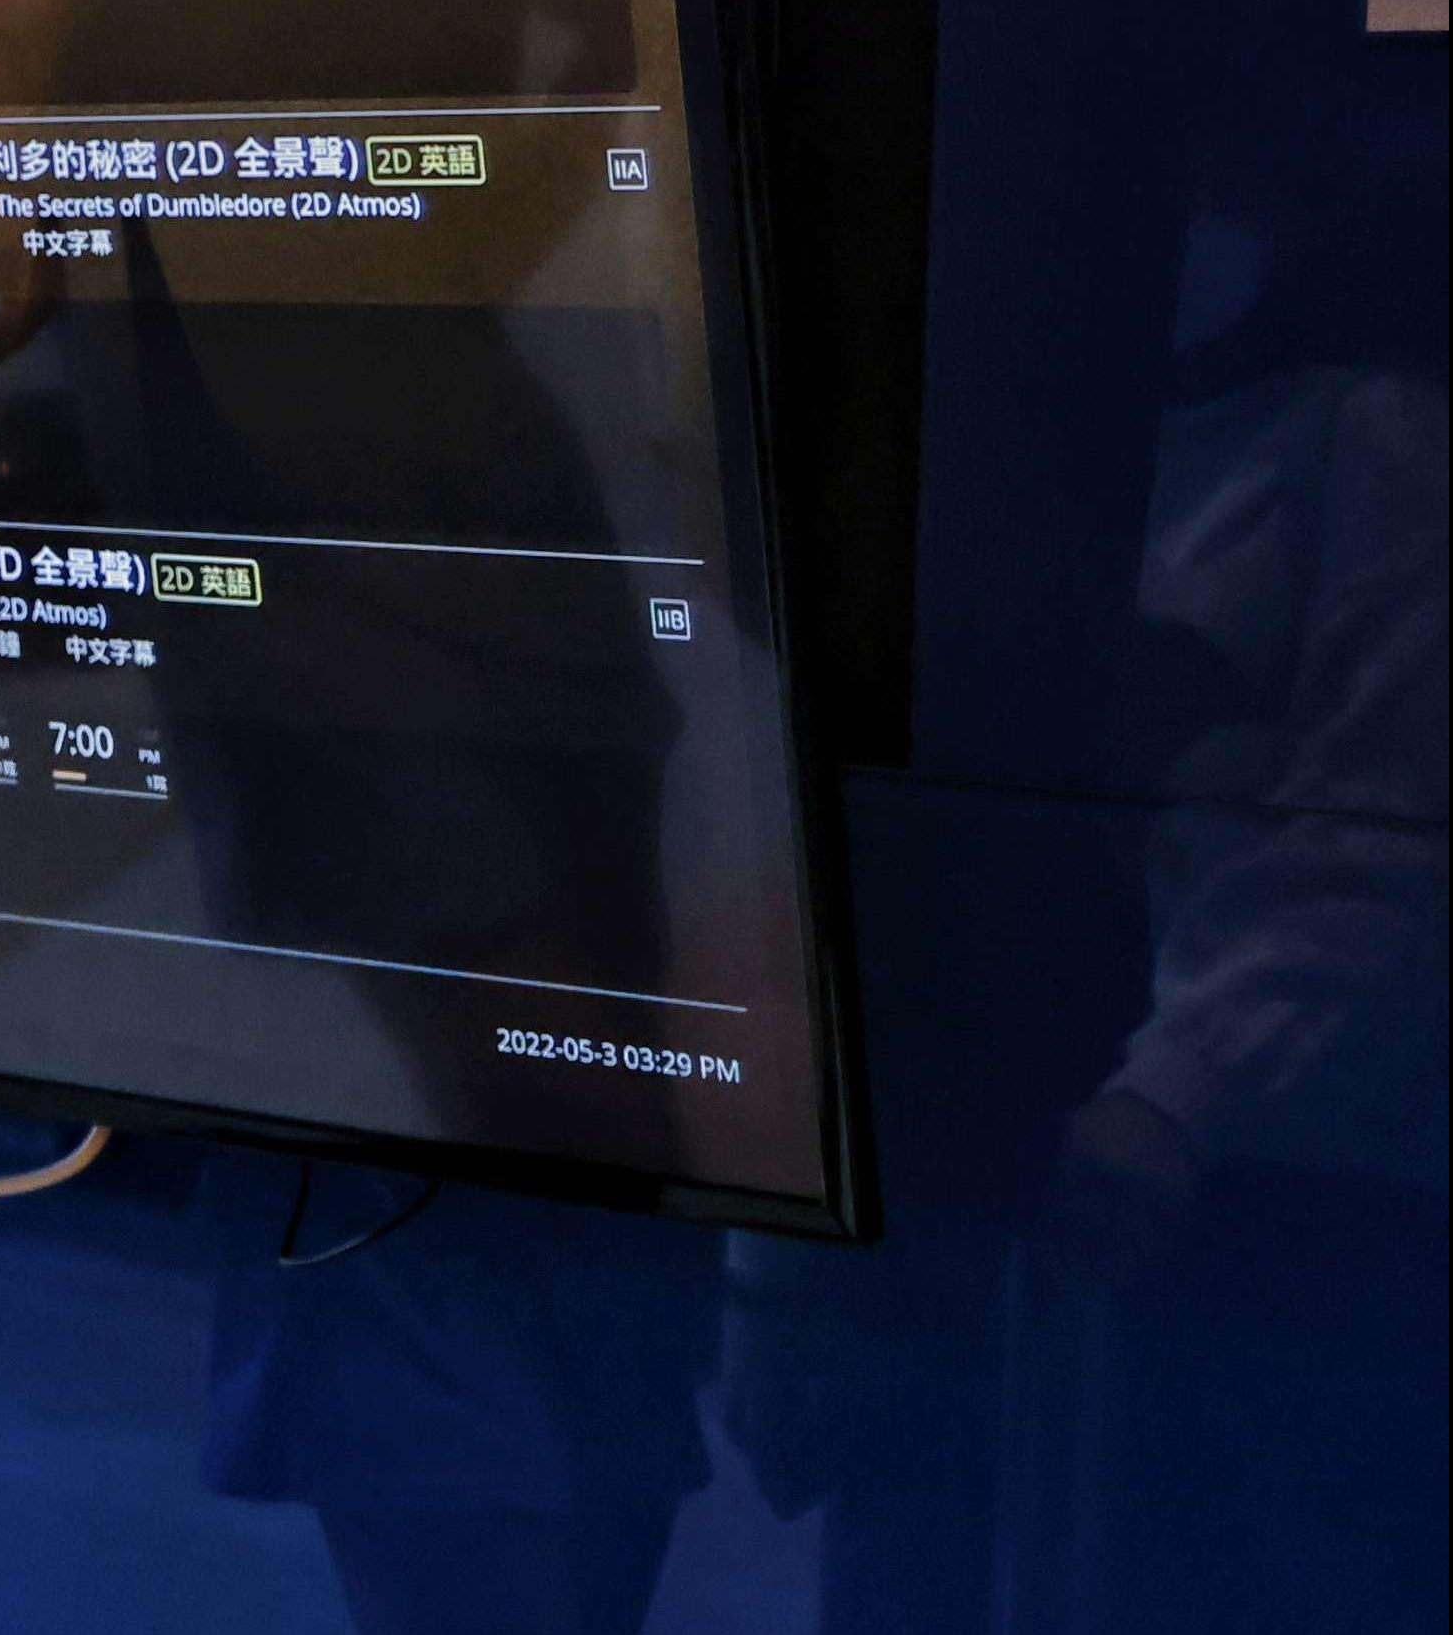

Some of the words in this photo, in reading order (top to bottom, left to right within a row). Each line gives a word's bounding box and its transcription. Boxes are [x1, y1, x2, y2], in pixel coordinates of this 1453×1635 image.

[165, 140, 225, 183] (2D
[234, 136, 360, 182] 全景聲)
[375, 148, 413, 175] 2D
[419, 145, 478, 177] 英語
[613, 157, 642, 182] IIA
[41, 193, 115, 218] Secrets
[119, 193, 143, 217] of
[146, 193, 287, 217] Dumbledore
[291, 192, 331, 220] (2D
[337, 192, 423, 220] Atmos)
[22, 228, 114, 257] 中文字幕
[30, 544, 147, 596] 全景聲)
[159, 565, 195, 593] 2D
[199, 565, 252, 599] 英語
[31, 600, 108, 631] Atmos)
[656, 607, 686, 633] IIB
[64, 634, 157, 668] 中文字幕
[48, 719, 115, 760] 7:00
[496, 1027, 618, 1068] 2022-05-3
[623, 1044, 692, 1077] 03:29
[698, 1054, 741, 1084] PM
